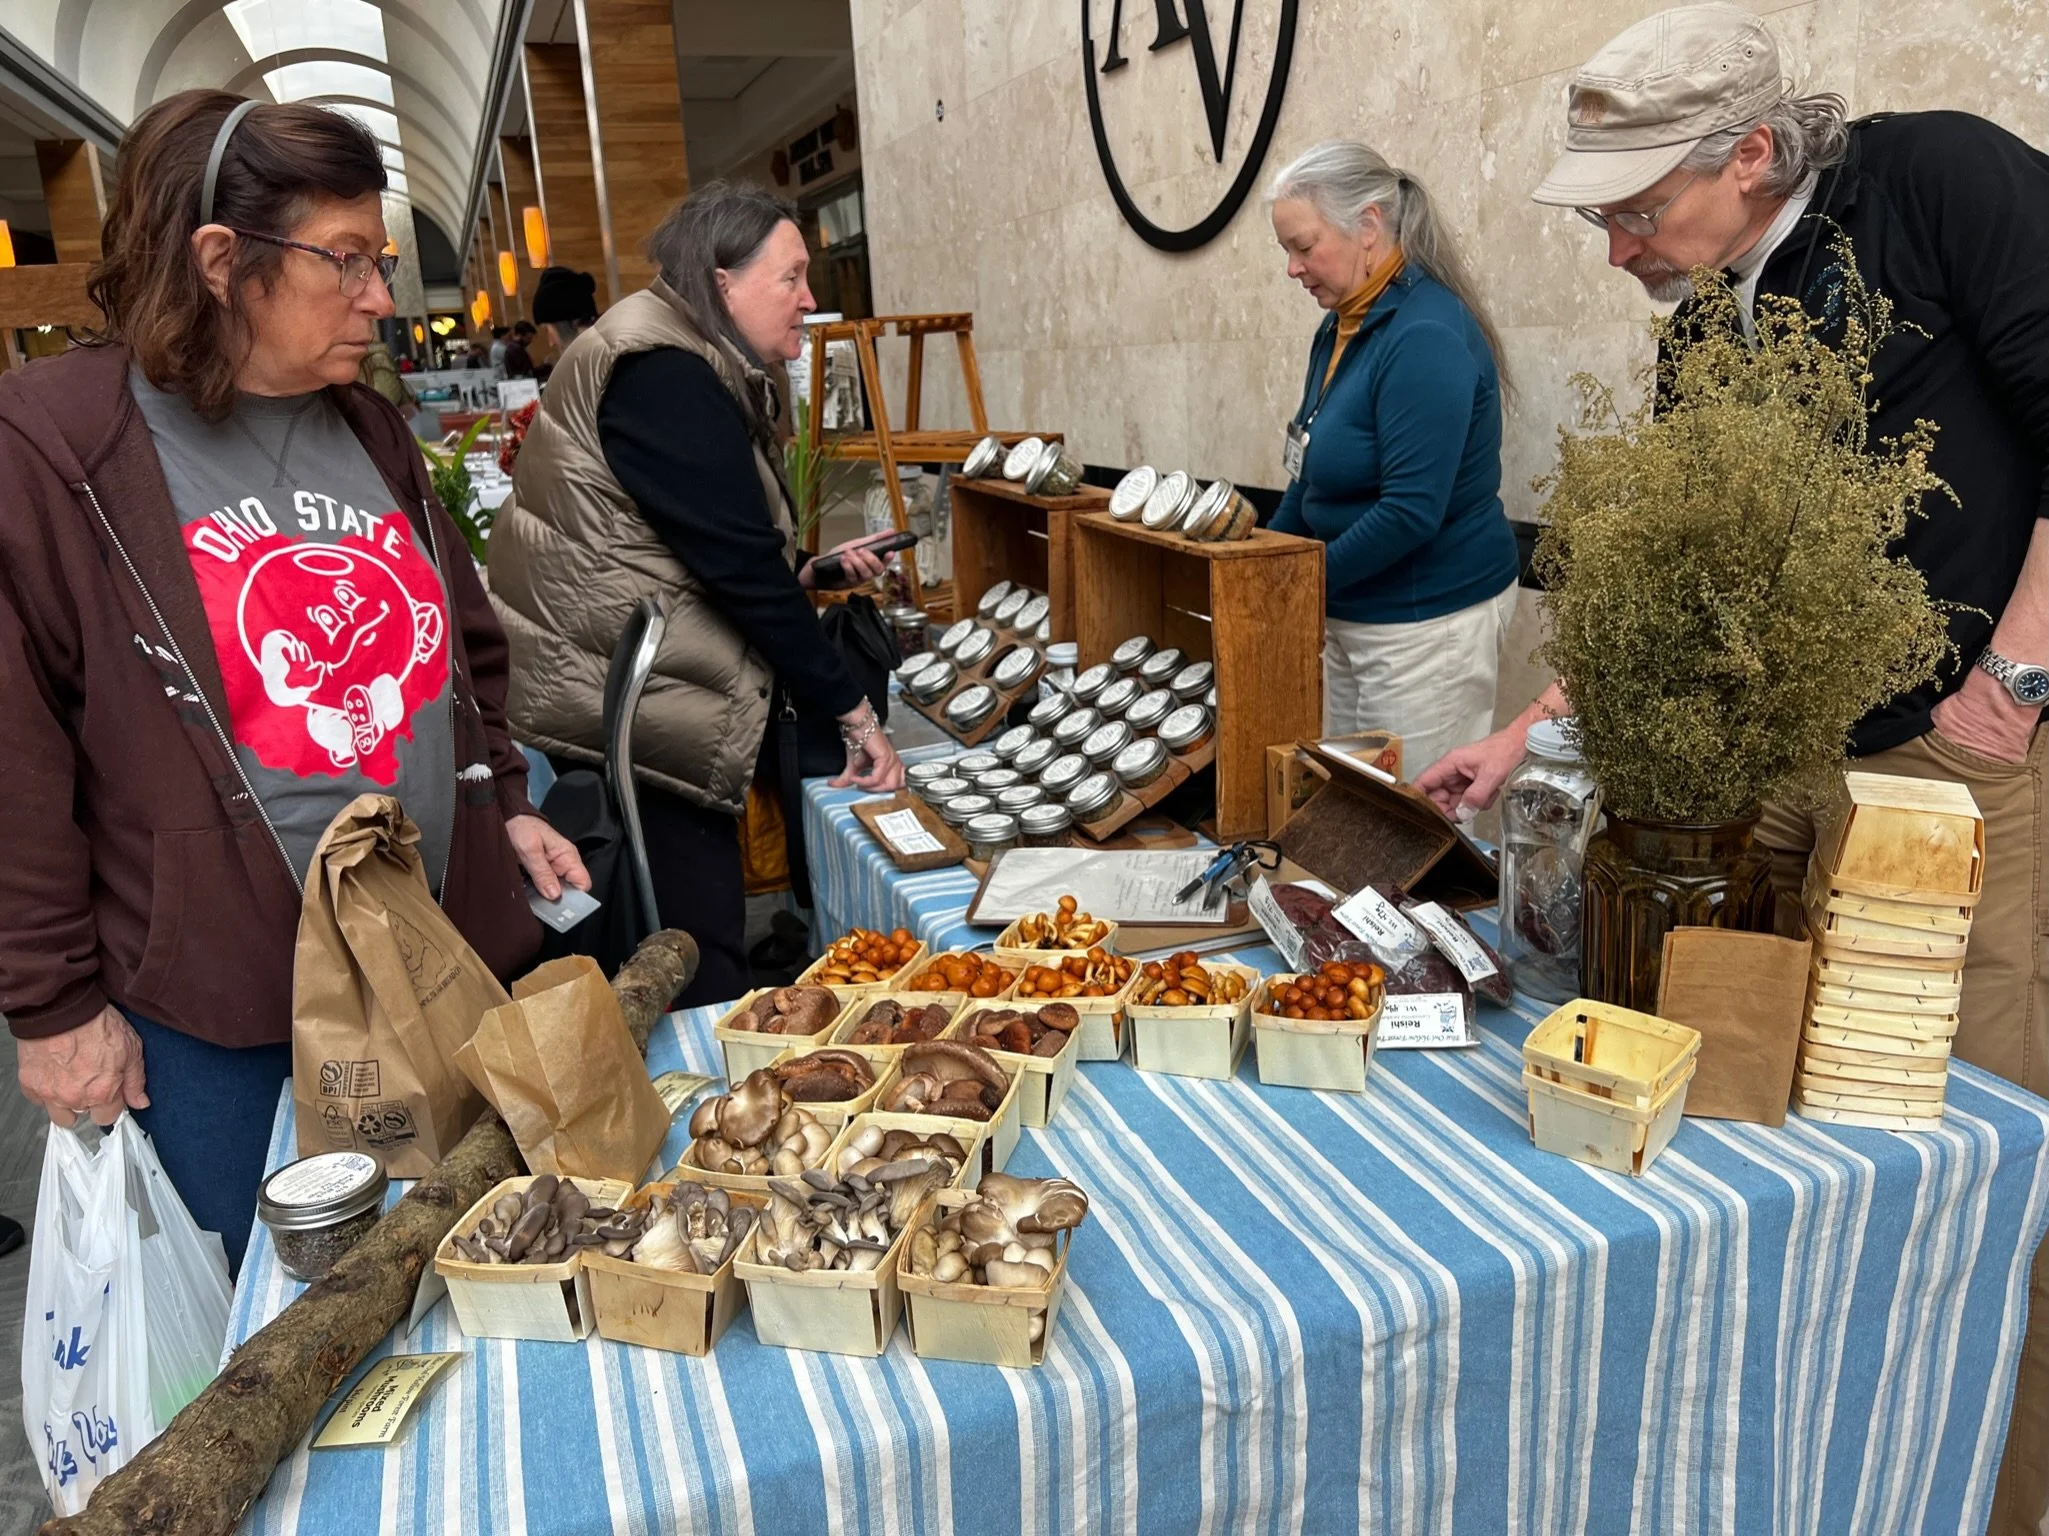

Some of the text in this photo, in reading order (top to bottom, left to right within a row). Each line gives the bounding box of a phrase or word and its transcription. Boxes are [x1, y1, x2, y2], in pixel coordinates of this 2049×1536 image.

[192, 490, 409, 563] OHIO STATE
[1360, 914, 1385, 937] Reishi
[1391, 1020, 1420, 1028] Reishi
[323, 1085, 337, 1095] BPI
[351, 1375, 398, 1428] Mushrooms
[371, 1384, 399, 1413] Mixed
[378, 1416, 397, 1438] Farm
